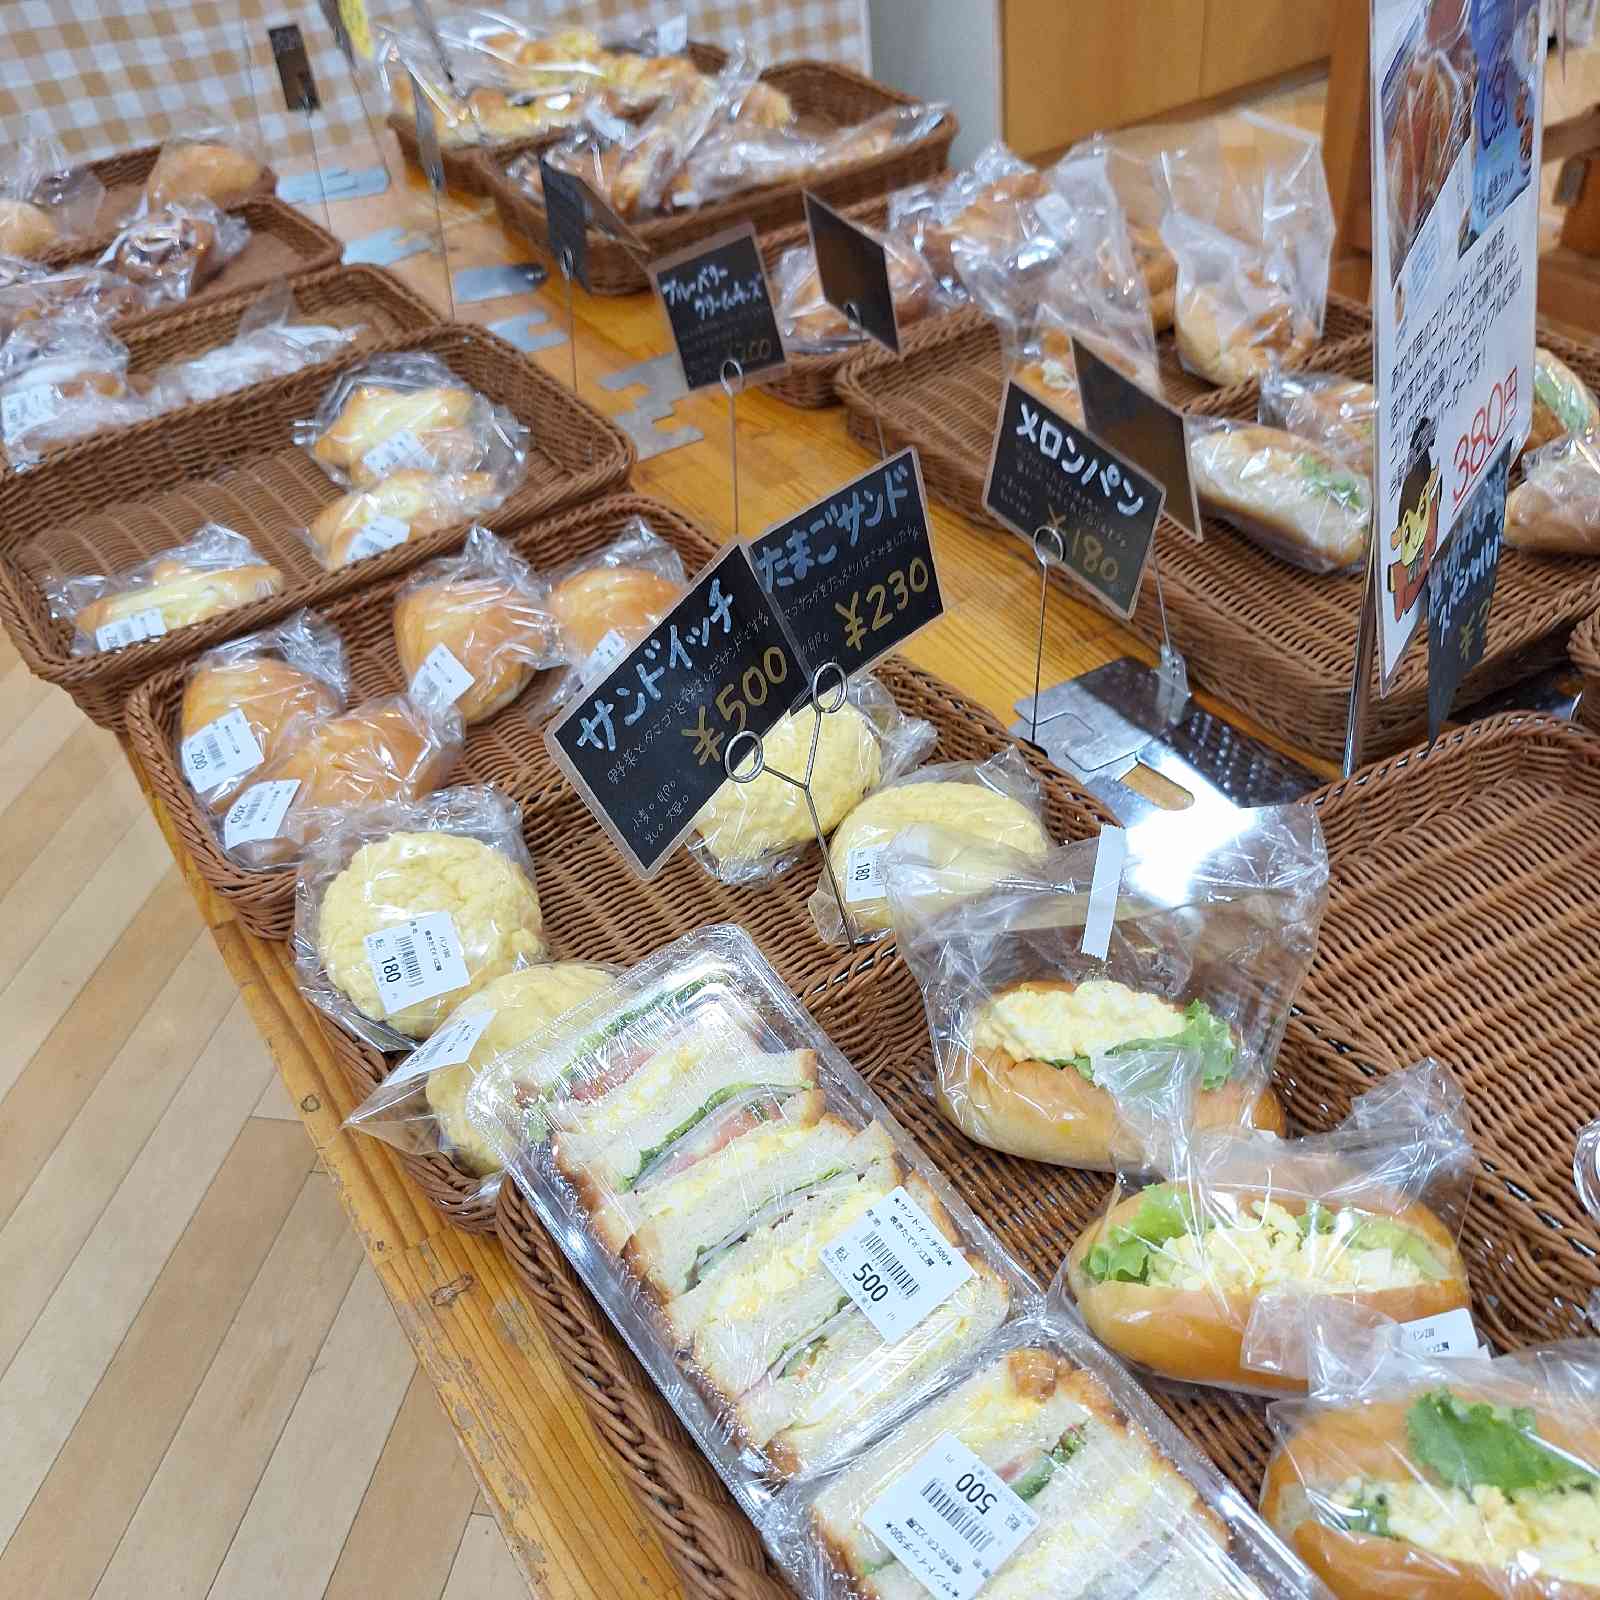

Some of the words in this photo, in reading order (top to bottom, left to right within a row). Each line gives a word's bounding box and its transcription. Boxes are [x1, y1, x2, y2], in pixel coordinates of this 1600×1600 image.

[1016, 402, 1143, 516] メロンパン
[1453, 366, 1518, 501] 380円
[754, 464, 908, 593] たまごサンド
[834, 557, 929, 651] ¥230
[577, 578, 733, 750] サンドイッチ
[681, 646, 787, 766] ¥500
[855, 863, 871, 881] 180
[380, 955, 402, 983] 180
[852, 1261, 889, 1302] 500
[955, 1472, 999, 1516] 500
